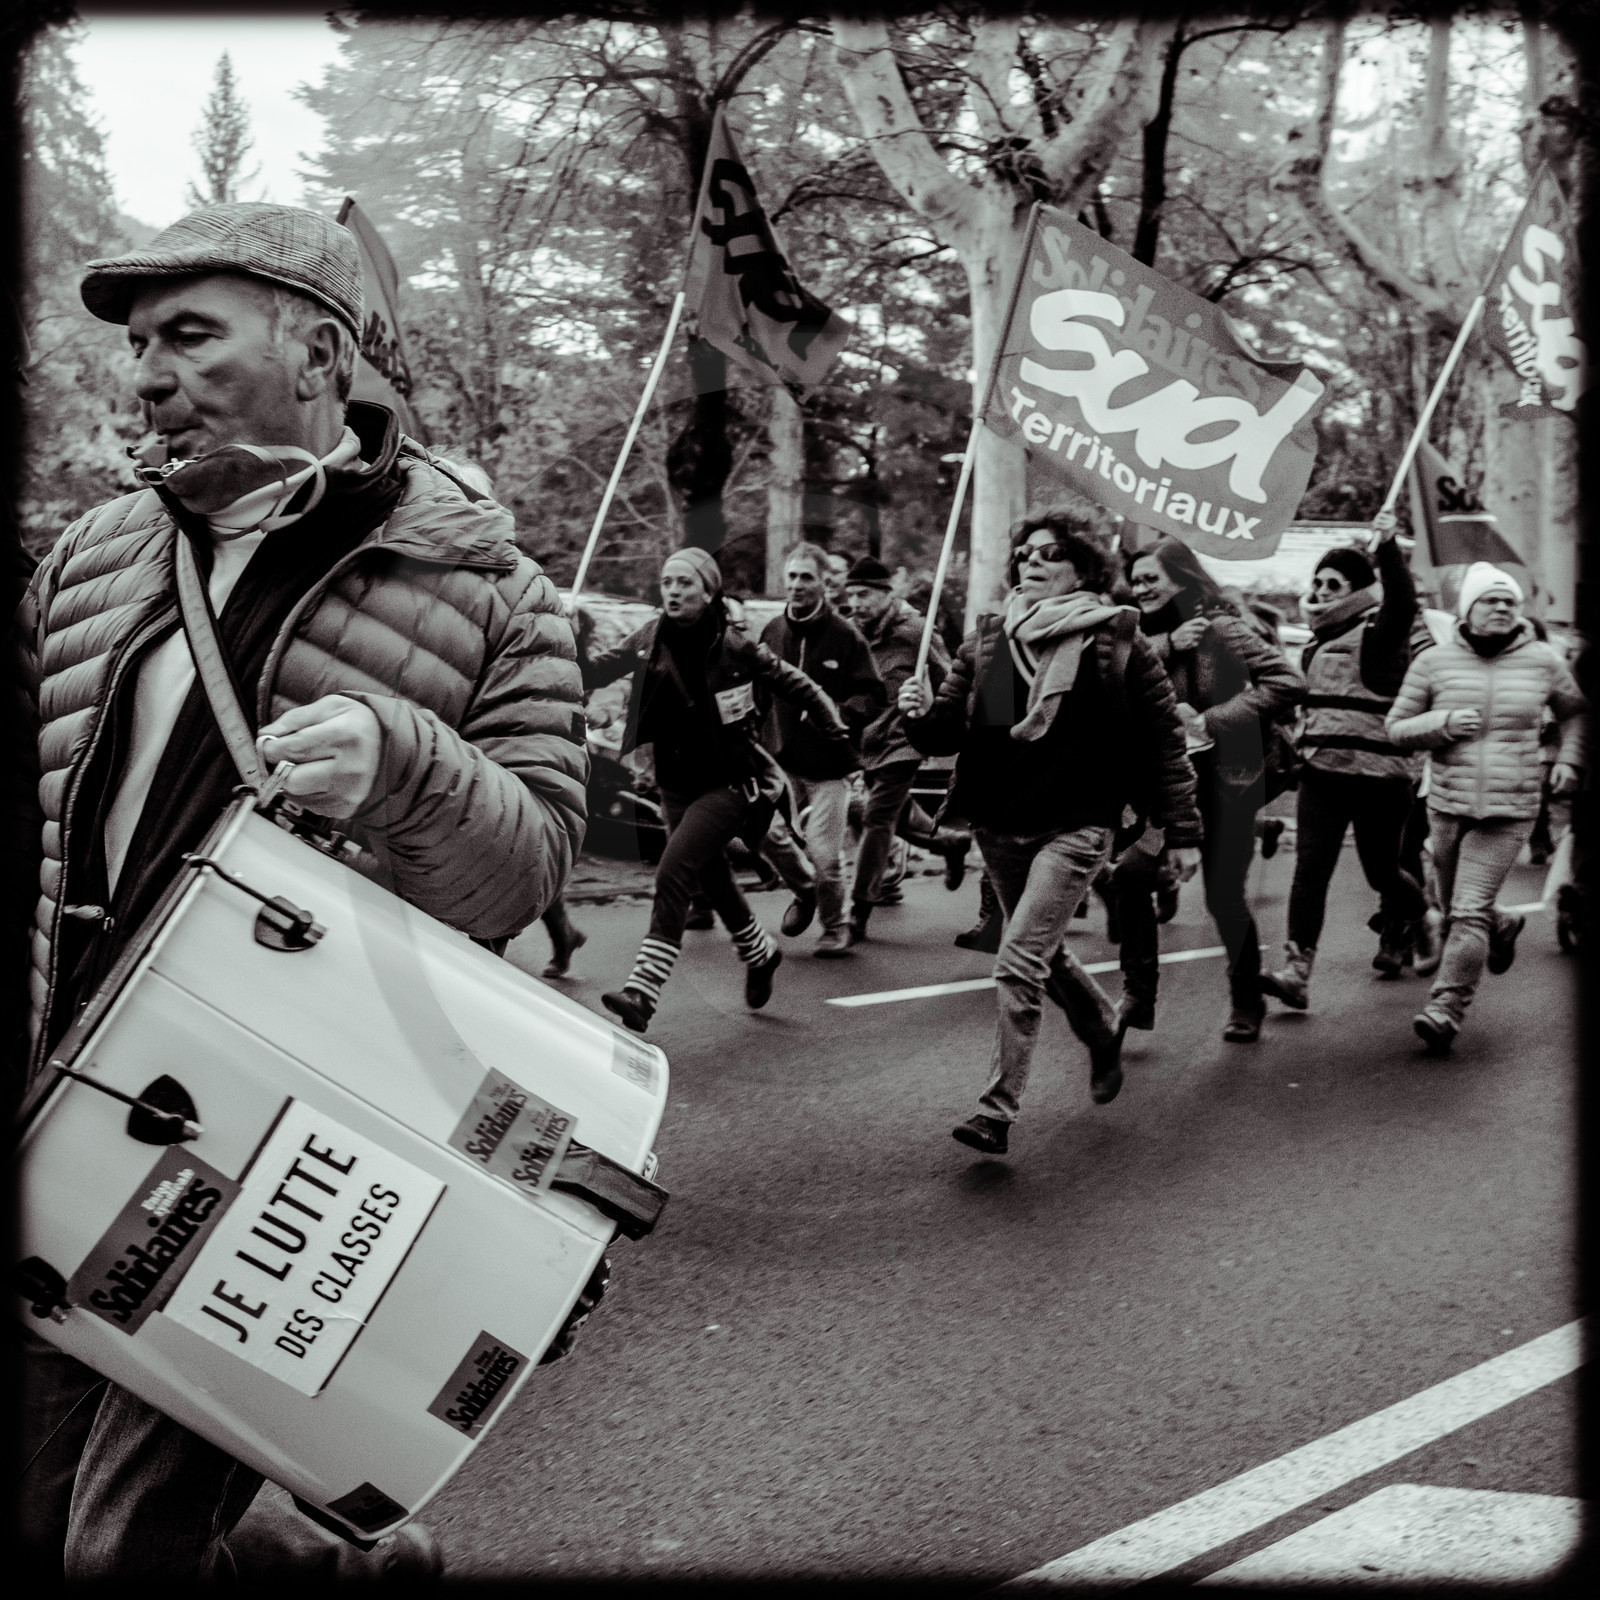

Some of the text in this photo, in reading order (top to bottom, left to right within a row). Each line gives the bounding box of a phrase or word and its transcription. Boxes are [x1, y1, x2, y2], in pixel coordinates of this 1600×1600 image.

[1010, 386, 1262, 541] Territoriaux
[1019, 288, 1325, 504] Sud
[89, 1178, 222, 1324] Solidaires
[200, 1133, 358, 1344] JE LUTTE
[273, 1183, 401, 1359] DES CLASSES
[445, 1350, 520, 1431] Solidaires
